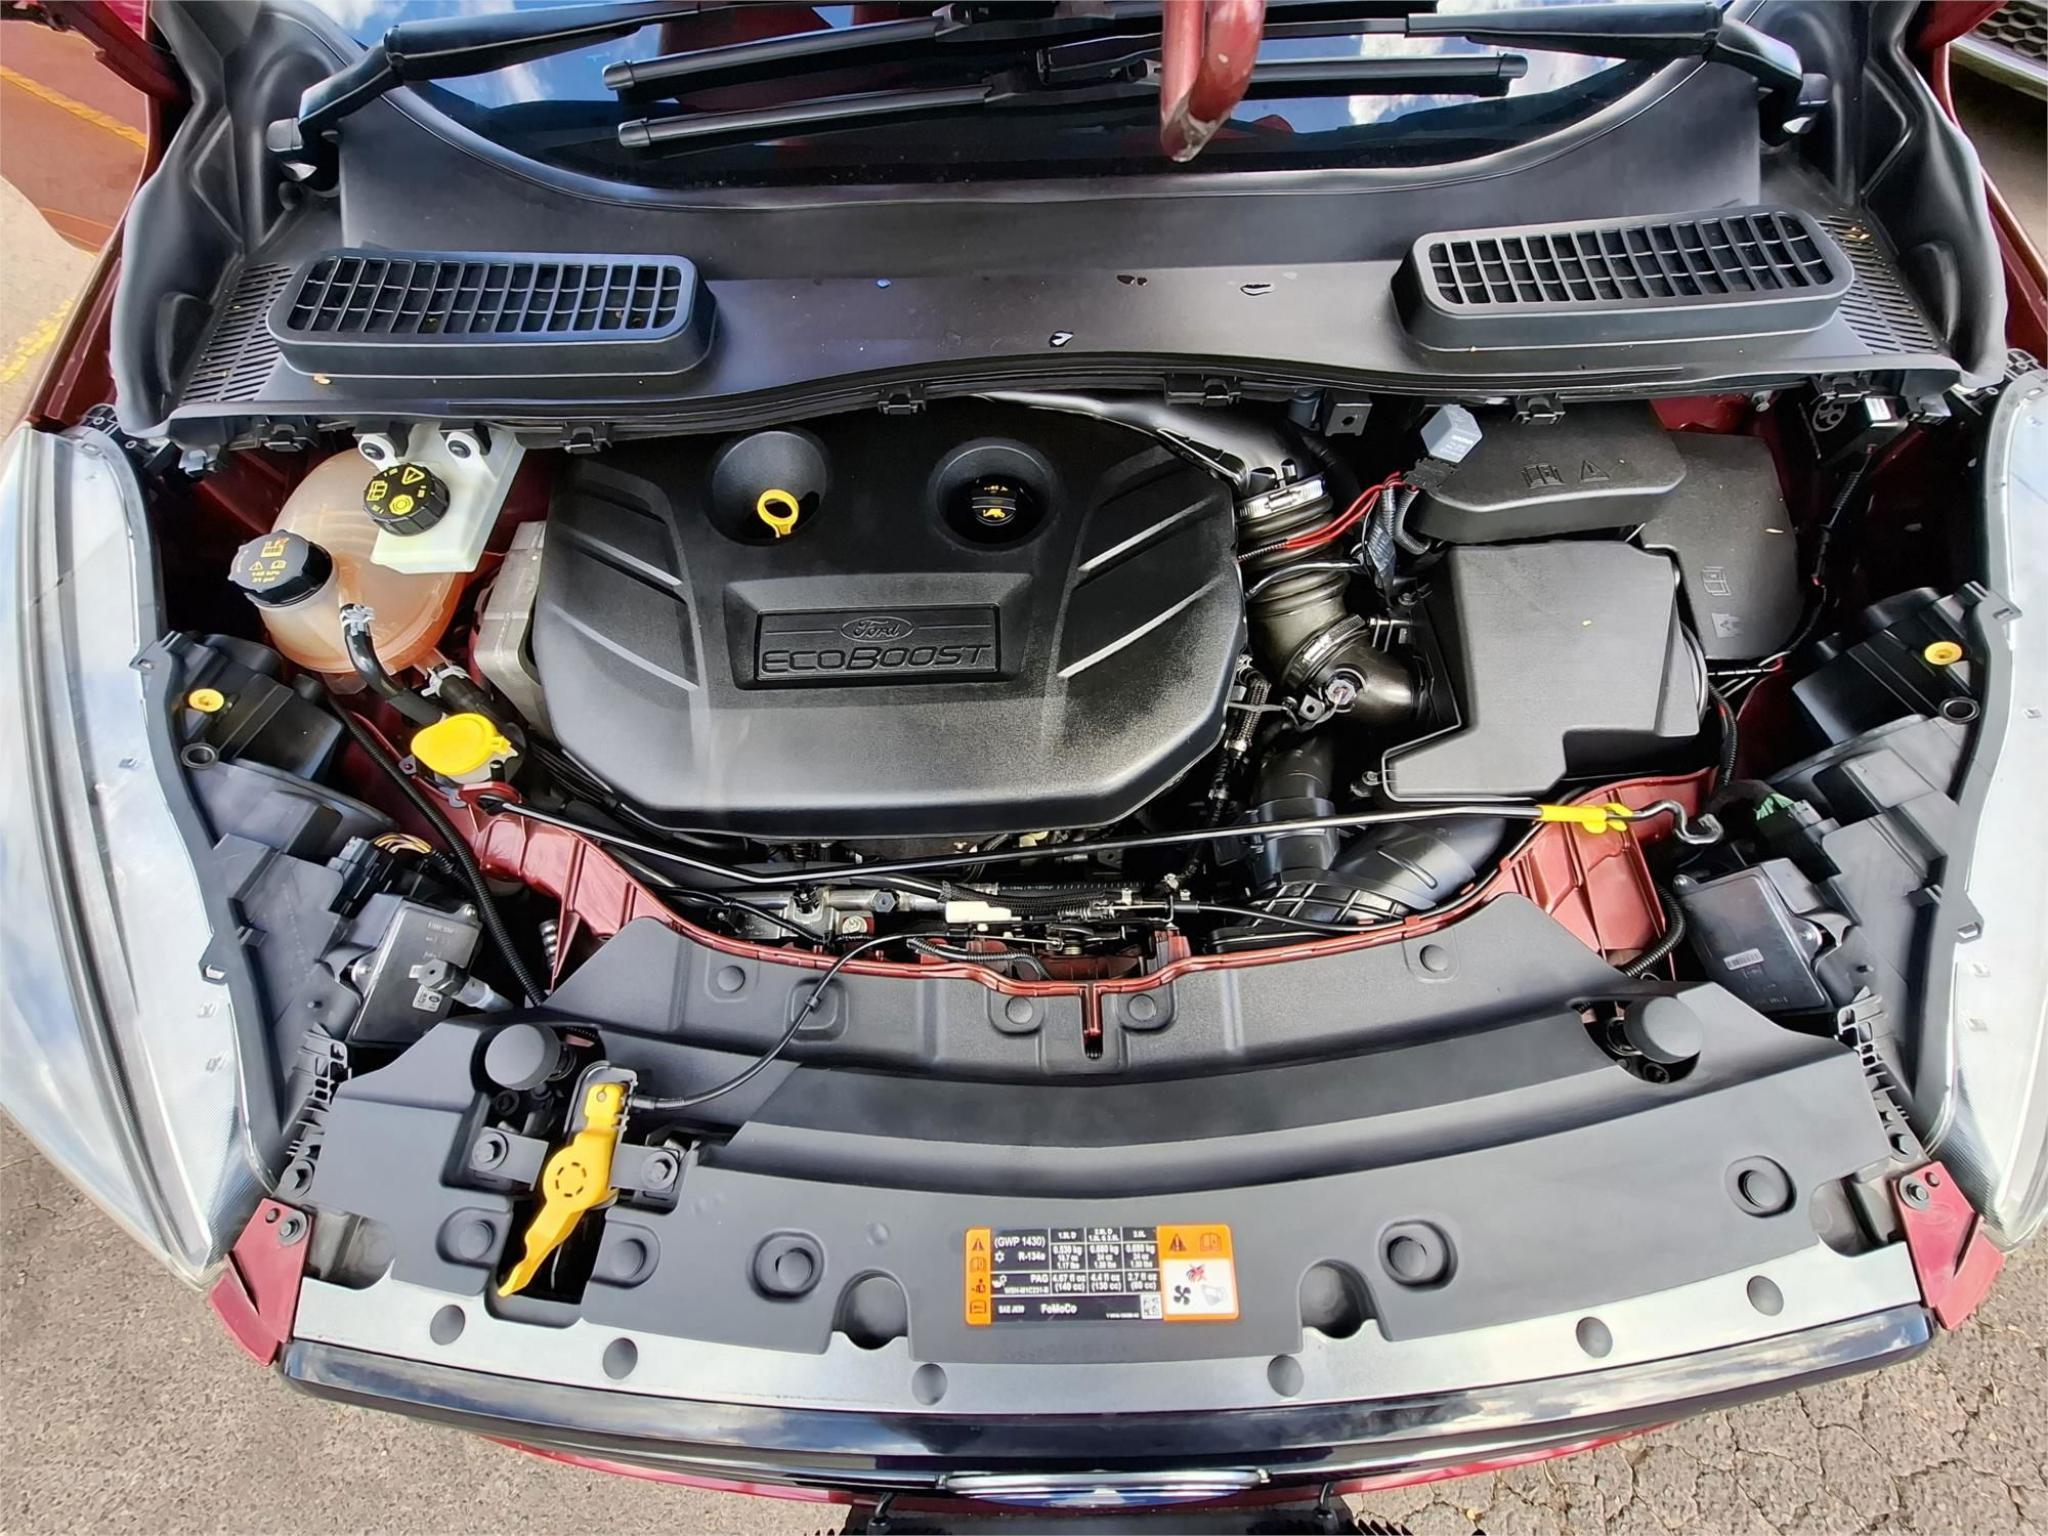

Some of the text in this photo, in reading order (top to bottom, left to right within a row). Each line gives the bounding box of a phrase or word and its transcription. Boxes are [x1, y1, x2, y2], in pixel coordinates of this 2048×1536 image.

[853, 619, 900, 638] Ford
[994, 1236, 1046, 1248] (GWP 1430)
[1073, 1245, 1082, 1256] kg
[1109, 1244, 1119, 1255] kg
[1145, 1244, 1155, 1254] kg
[1018, 1251, 1046, 1262] R-134a
[1030, 1273, 1049, 1284] PAG
[1090, 1273, 1103, 1281] 4.4
[1103, 1273, 1109, 1281] fl
[1127, 1273, 1140, 1281] 2.7
[1147, 1273, 1157, 1281] oz
[1054, 1282, 1085, 1292] (140 cc)
[1091, 1282, 1121, 1292] (130 cc)
[1144, 1281, 1157, 1291] cc)
[1040, 1303, 1078, 1315] FoMoCo
